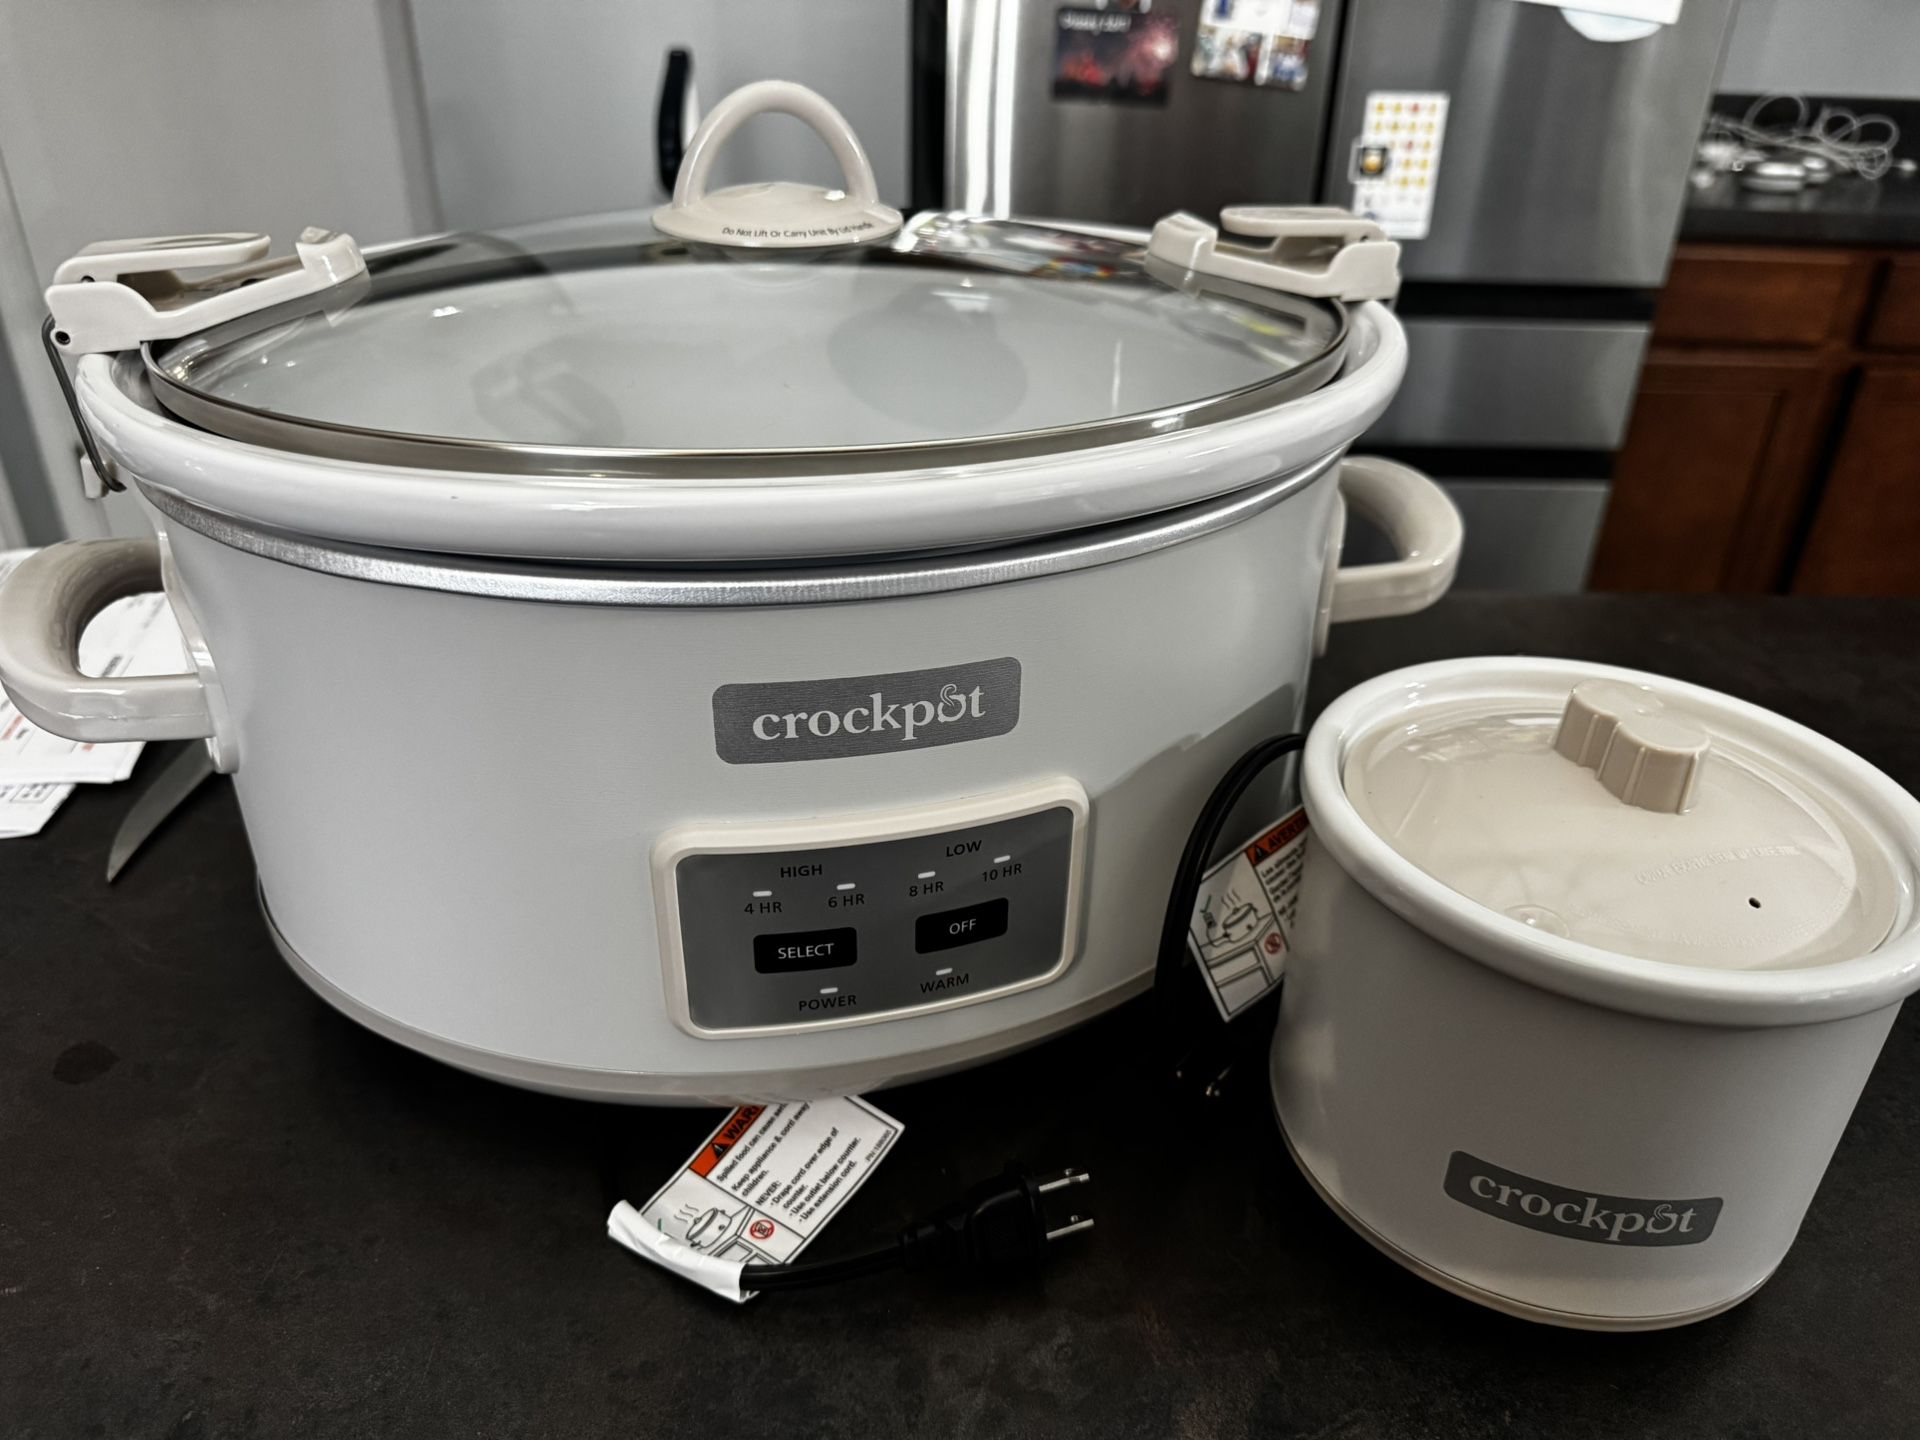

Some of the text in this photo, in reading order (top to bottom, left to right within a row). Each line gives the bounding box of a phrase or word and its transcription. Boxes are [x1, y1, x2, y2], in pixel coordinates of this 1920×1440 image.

[721, 226, 735, 235] Do
[736, 228, 752, 237] Not
[754, 229, 768, 237] Lift
[783, 230, 807, 238] Carry
[752, 683, 986, 741] crockpot
[946, 840, 983, 858] LOW
[780, 864, 823, 878] HIGH
[982, 863, 1023, 882] 10 HR
[909, 881, 944, 897] 8 HR
[743, 901, 783, 915] 4 HR
[828, 893, 865, 908] 6 HR
[949, 918, 977, 935] OFF
[777, 943, 835, 960] SELECT
[920, 973, 970, 993] WARM
[799, 994, 857, 1012] POWER
[716, 1159, 738, 1182] Spilled
[734, 1144, 751, 1161] food
[748, 1134, 760, 1146] can
[758, 1115, 775, 1134] cause
[731, 1173, 750, 1191] Keep
[748, 1142, 777, 1174] appliance
[780, 1118, 795, 1136] cord
[793, 1102, 810, 1120] away
[771, 1126, 839, 1203] Drape cord over edge of
[755, 1181, 781, 1205] NEVER:
[790, 1201, 806, 1214] Use
[804, 1182, 822, 1202] outlet
[819, 1163, 838, 1184] below
[800, 1206, 815, 1219] Use
[813, 1176, 843, 1208] extension
[1469, 1175, 1697, 1242] crockpot
